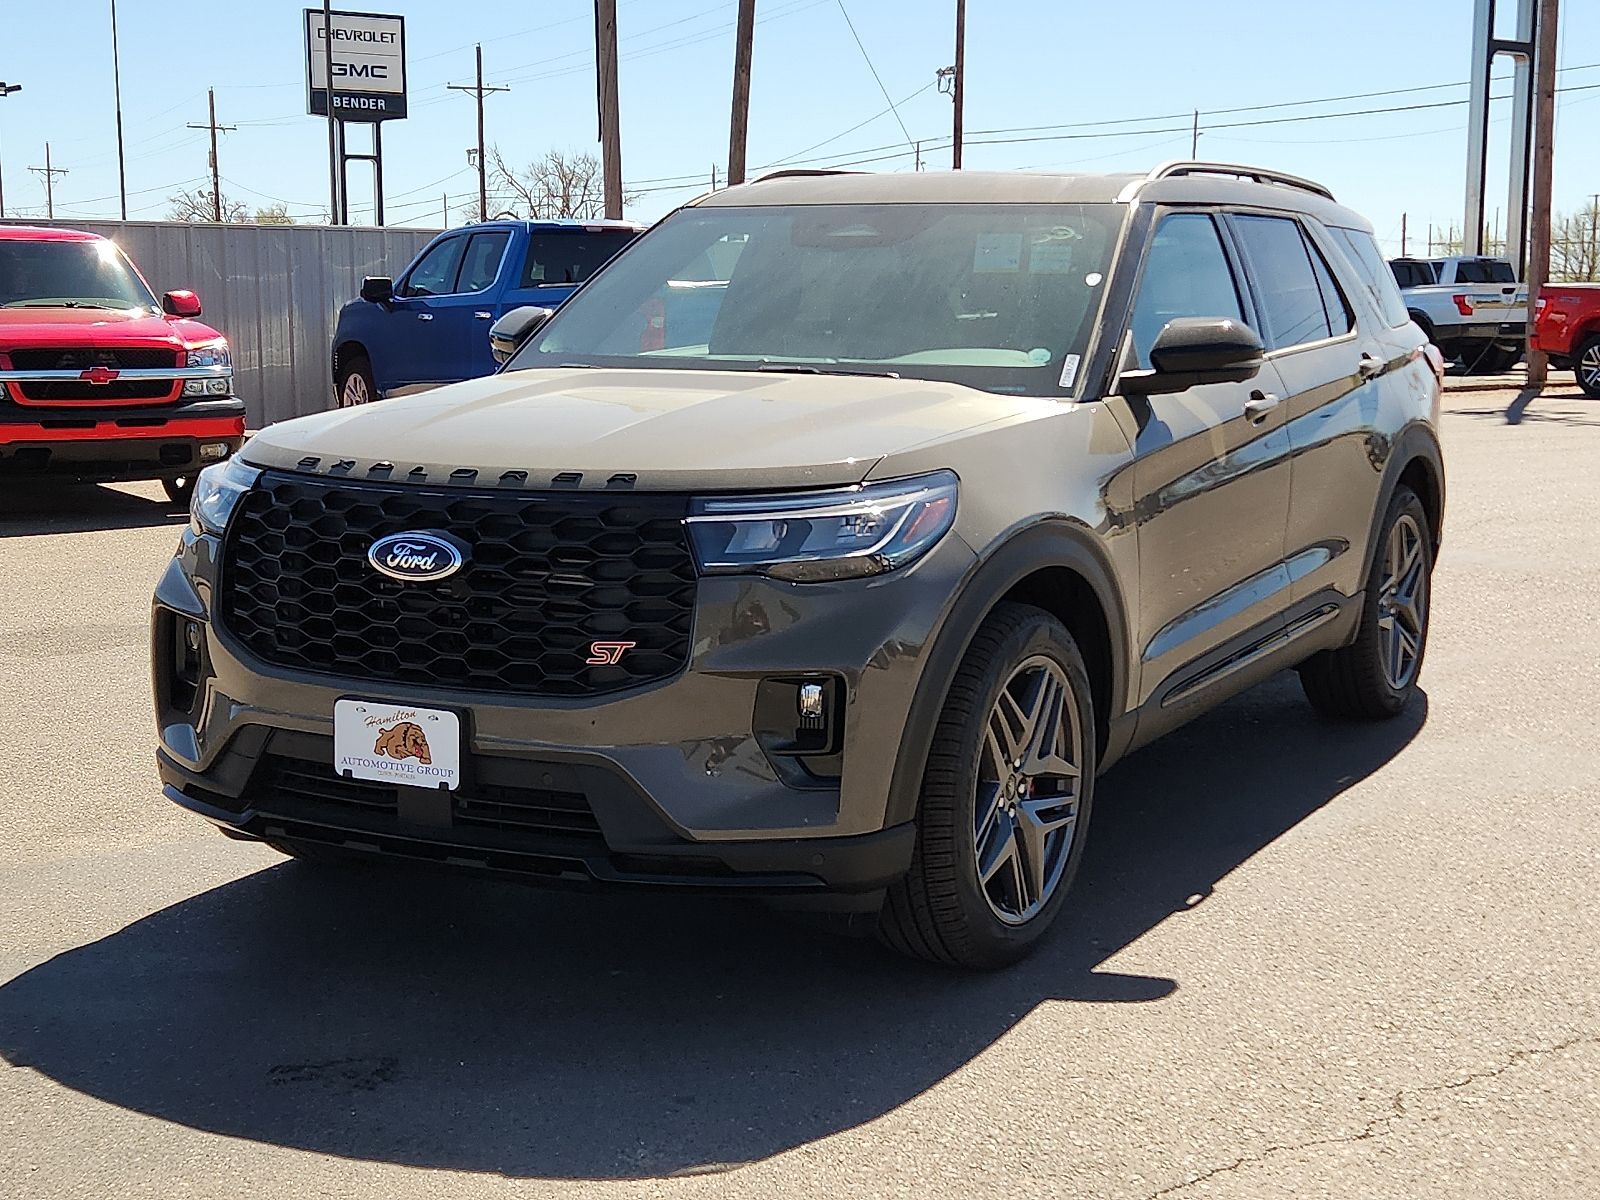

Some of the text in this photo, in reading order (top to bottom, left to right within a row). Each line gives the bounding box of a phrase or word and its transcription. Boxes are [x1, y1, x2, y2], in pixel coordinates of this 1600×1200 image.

[317, 28, 396, 43] CHEVROLET
[331, 62, 387, 78] GMC
[333, 96, 386, 110] BENDER
[297, 455, 637, 488] EXPLORER
[386, 542, 436, 570] Ford
[586, 641, 636, 665] ST
[364, 710, 417, 728] Hamilton
[341, 757, 414, 773] AUTOMOTIVE
[416, 765, 454, 778] GROUP
